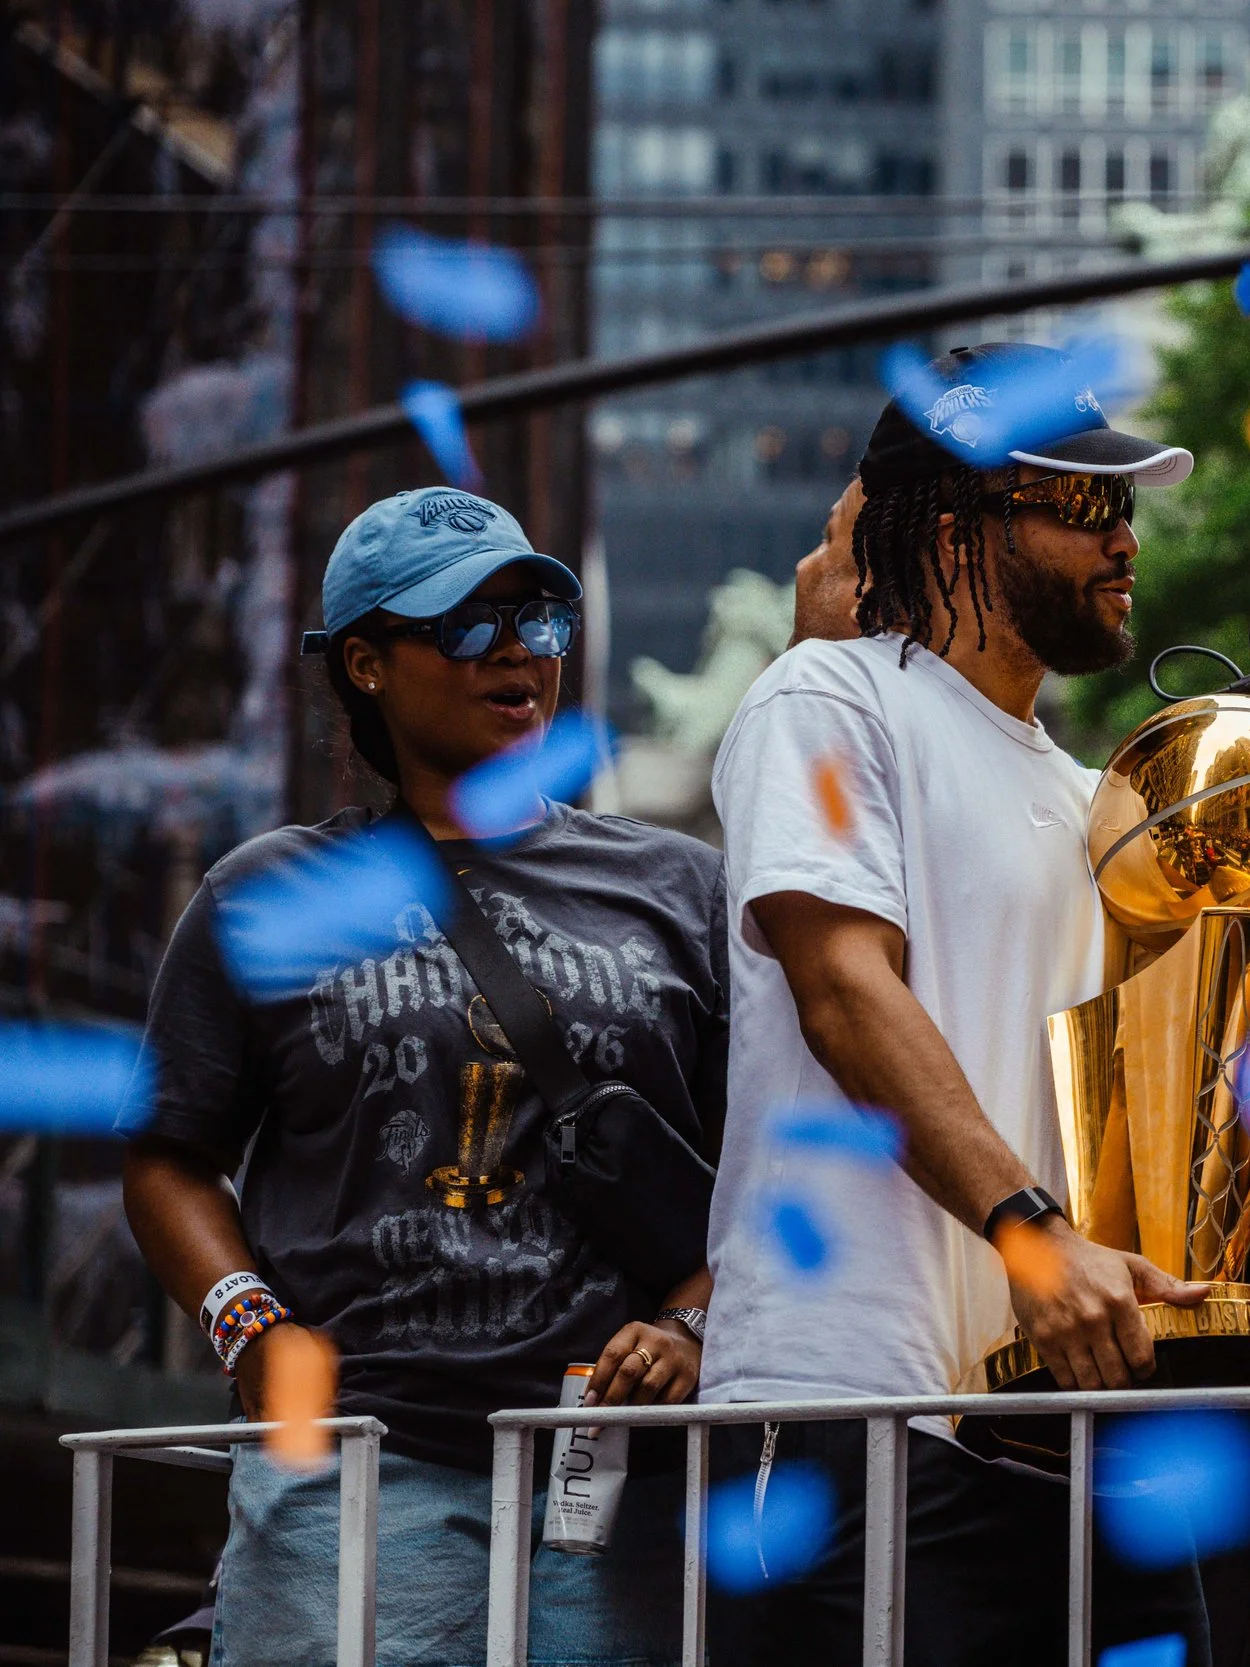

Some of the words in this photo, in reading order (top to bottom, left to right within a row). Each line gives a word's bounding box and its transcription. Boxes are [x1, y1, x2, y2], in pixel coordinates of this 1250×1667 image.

[308, 936, 662, 1066] CHAMIONS
[363, 1035, 428, 1098] 20
[566, 1021, 629, 1072] 26
[215, 1289, 224, 1299] 8
[552, 1500, 575, 1508] Vdka.
